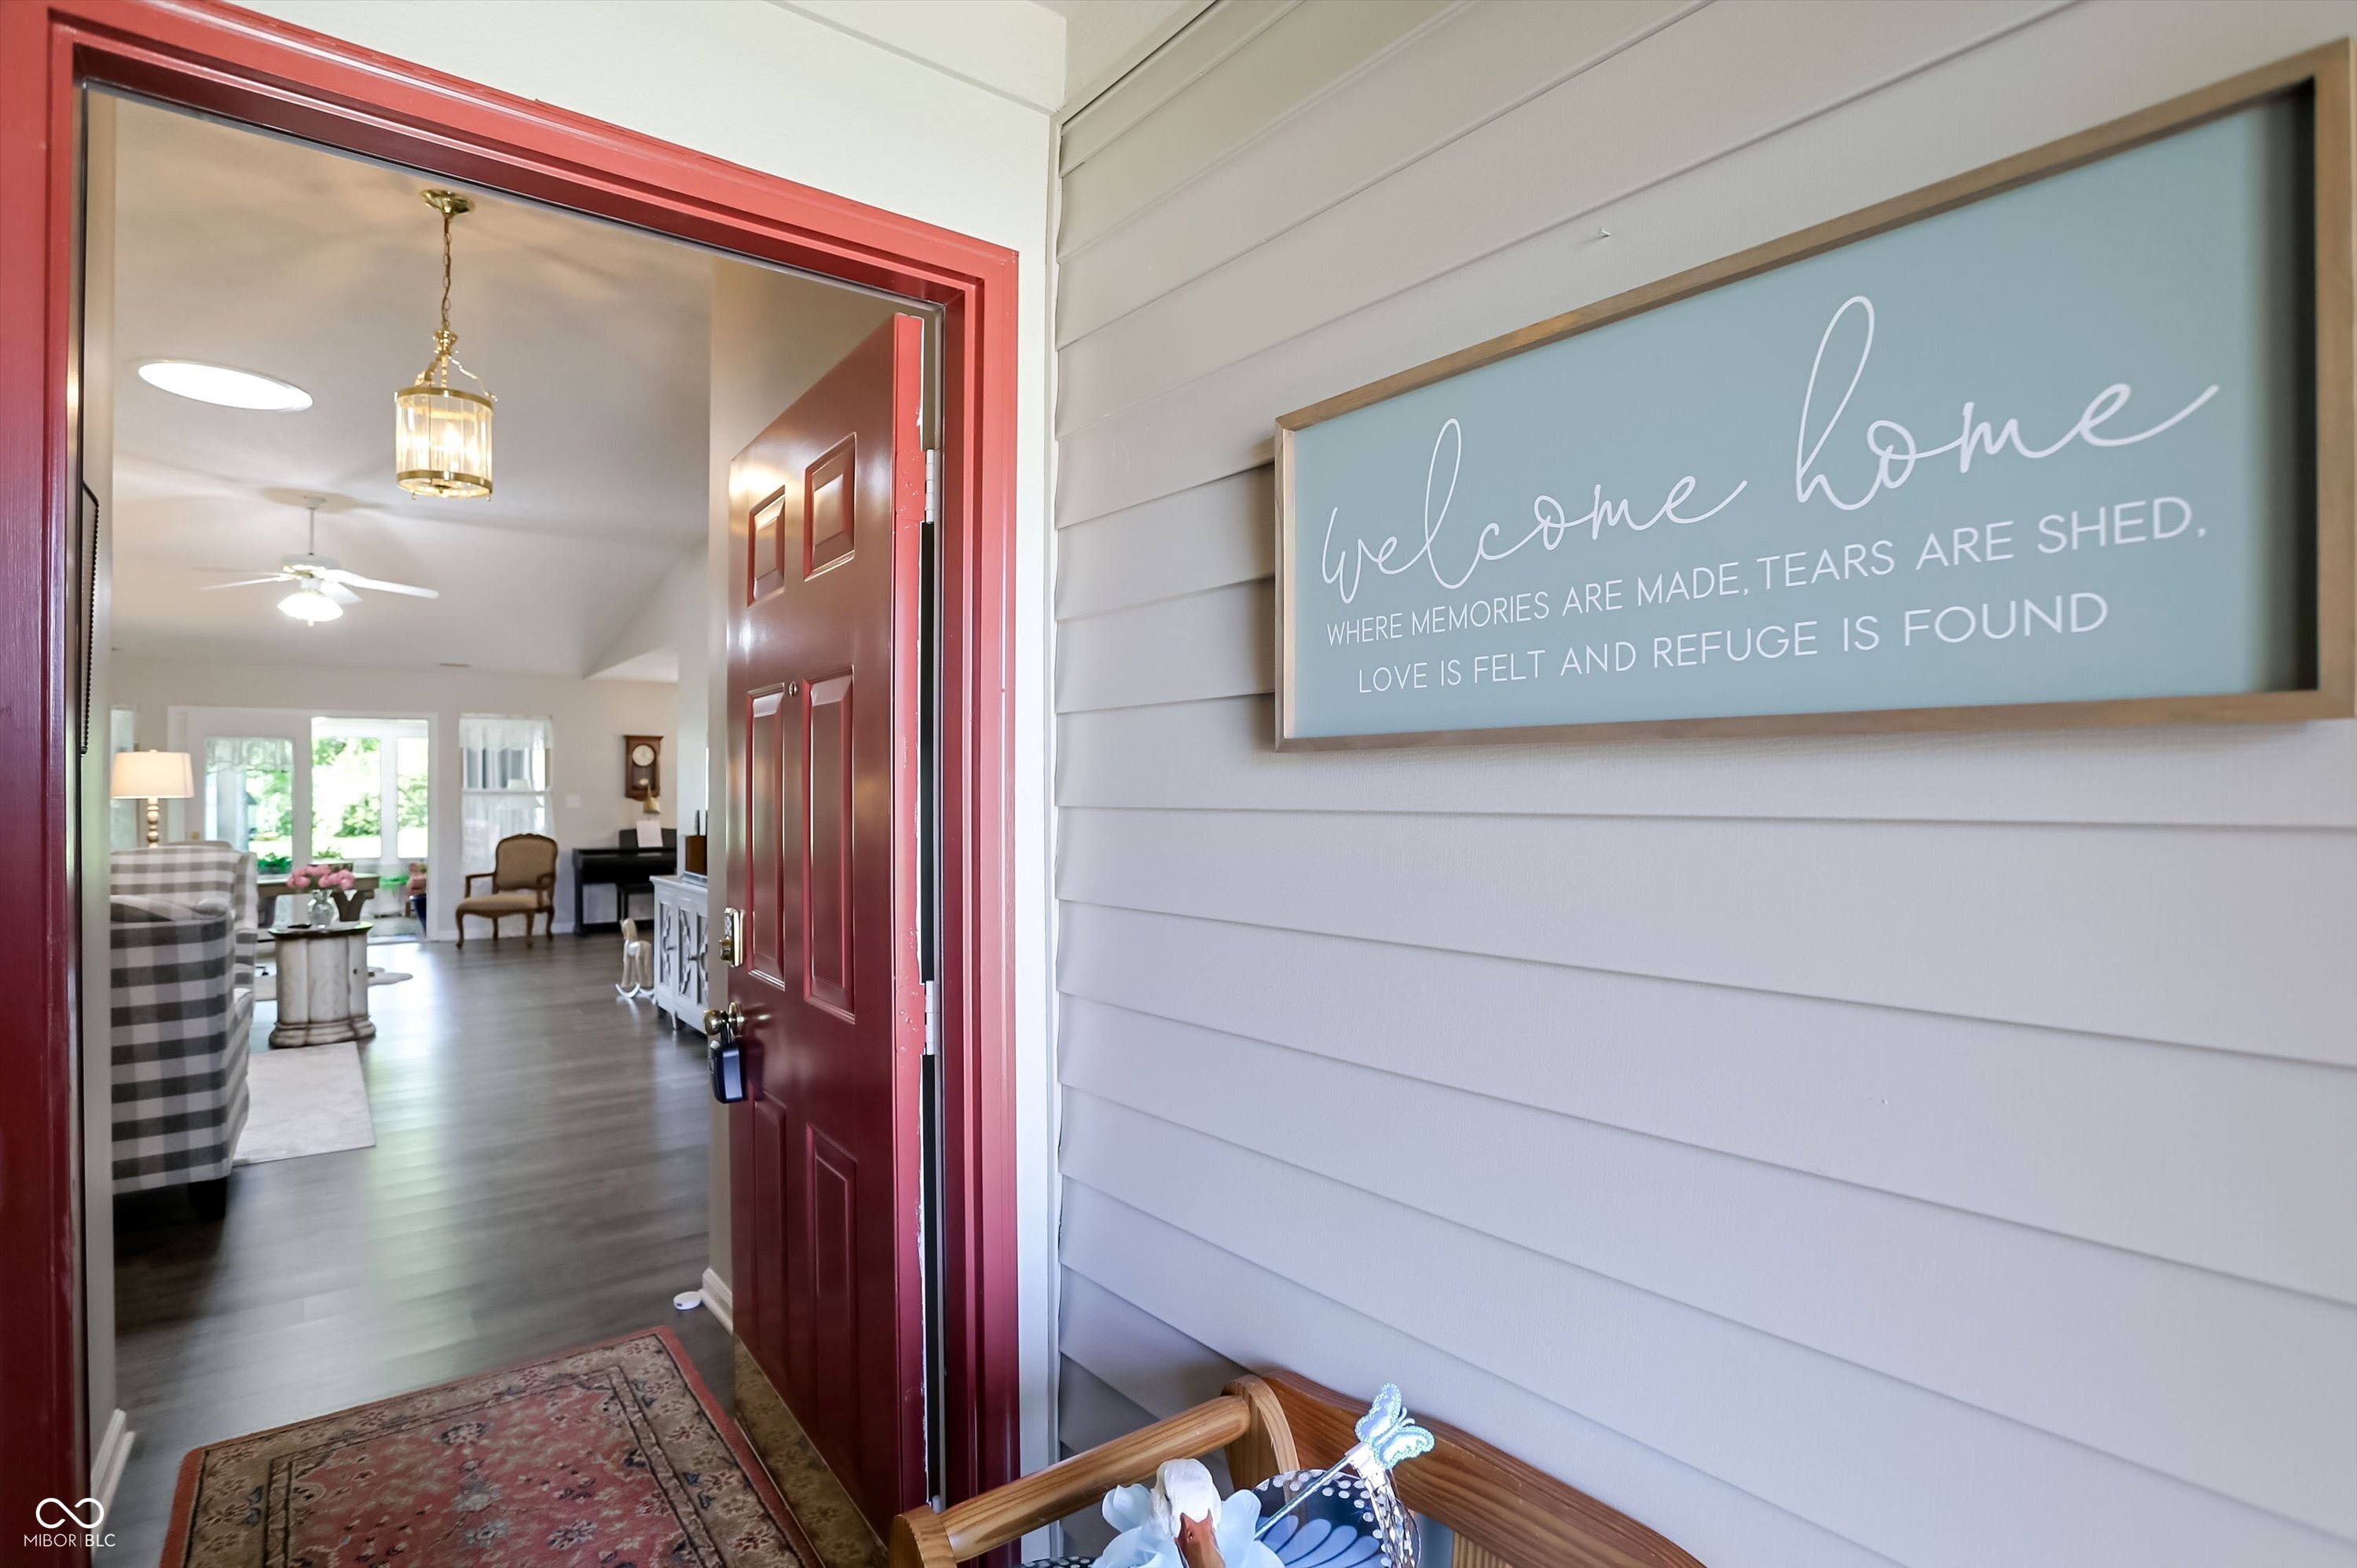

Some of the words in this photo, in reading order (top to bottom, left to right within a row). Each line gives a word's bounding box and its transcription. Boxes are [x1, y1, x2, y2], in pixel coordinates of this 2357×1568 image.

[1321, 418, 1748, 604] welcome
[1795, 295, 2220, 511] home
[1326, 612, 1403, 647] WHERE
[1412, 591, 1550, 636] MEMORIES
[1562, 579, 1623, 617] ARE
[1637, 561, 1750, 606] MADE,
[1756, 540, 1895, 590] TEARS
[1915, 520, 2014, 570] ARE
[2036, 496, 2207, 554] SHED,
[1359, 661, 1428, 694] LOVE
[1441, 659, 1462, 687] IS
[1474, 649, 1546, 684] FELT
[1560, 641, 1637, 676] AND
[1653, 621, 1818, 669] REFUGE
[1843, 615, 1880, 652] IS
[1904, 592, 2109, 647] FOUND
